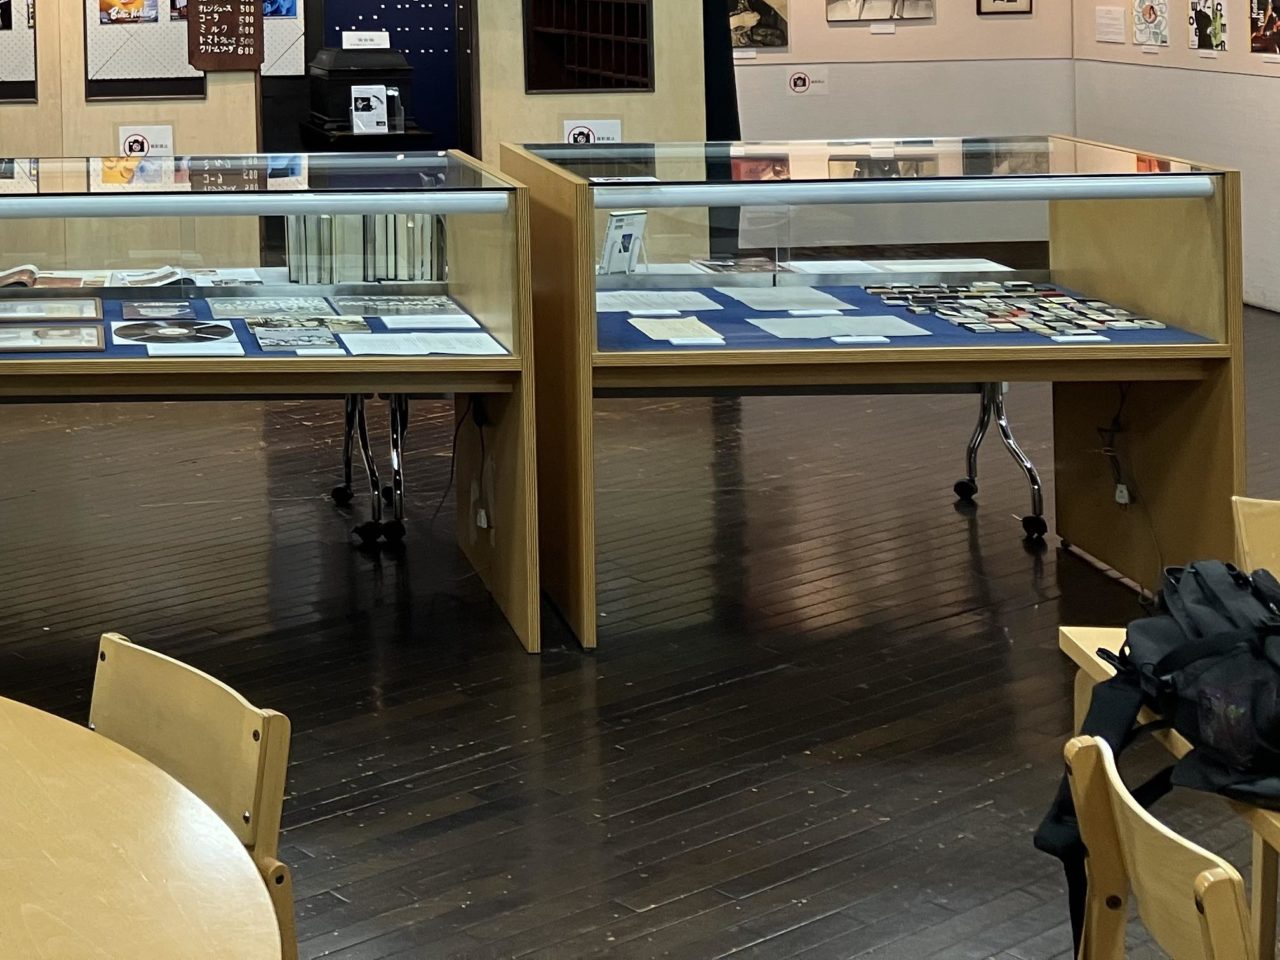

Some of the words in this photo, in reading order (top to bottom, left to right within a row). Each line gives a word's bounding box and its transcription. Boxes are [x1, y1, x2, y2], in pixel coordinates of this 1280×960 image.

[240, 5, 255, 13] 500
[199, 13, 220, 22] コーラ
[238, 15, 255, 25] 500
[238, 25, 255, 35] 500
[239, 37, 255, 46] 500
[237, 46, 255, 55] 600
